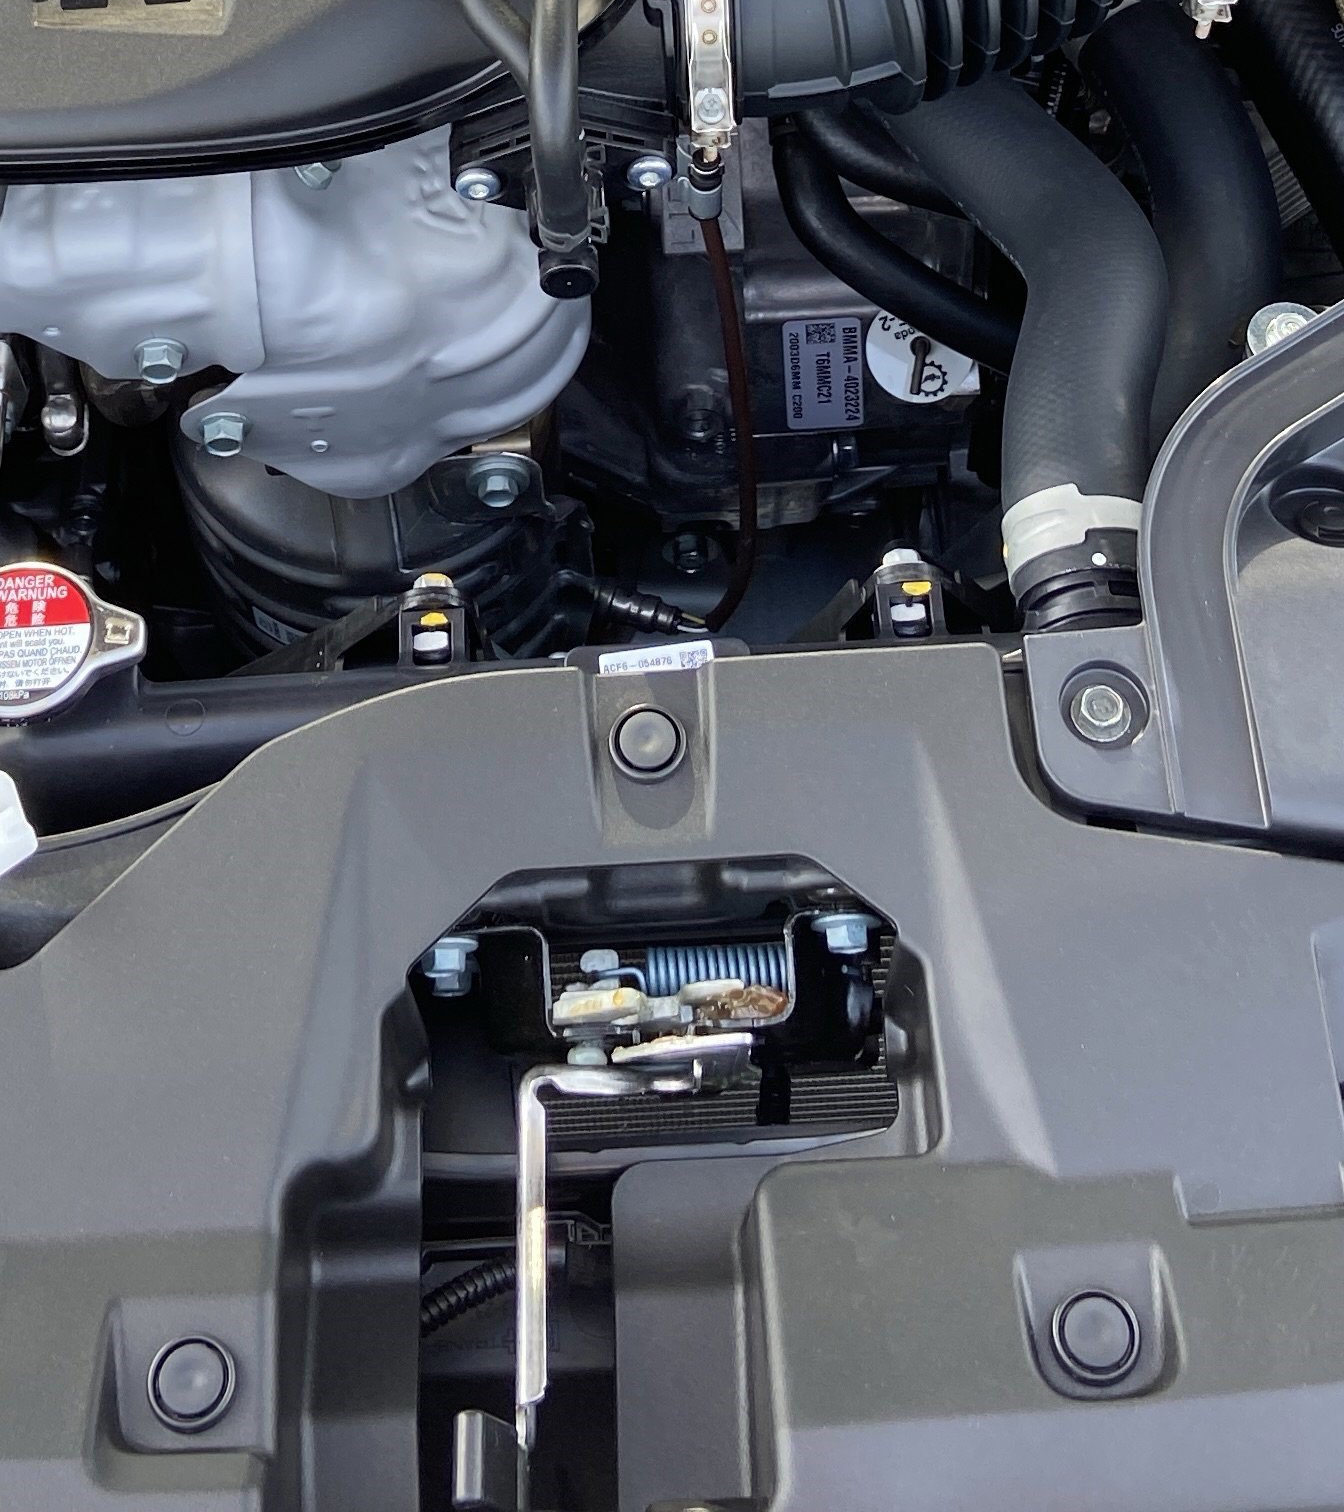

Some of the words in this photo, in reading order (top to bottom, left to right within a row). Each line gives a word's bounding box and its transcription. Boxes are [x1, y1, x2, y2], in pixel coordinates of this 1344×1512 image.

[24, 628, 52, 639] WHEN
[9, 639, 23, 648] will
[25, 637, 47, 647] scald
[17, 647, 49, 658] QUAND
[22, 658, 47, 668] MOTOR
